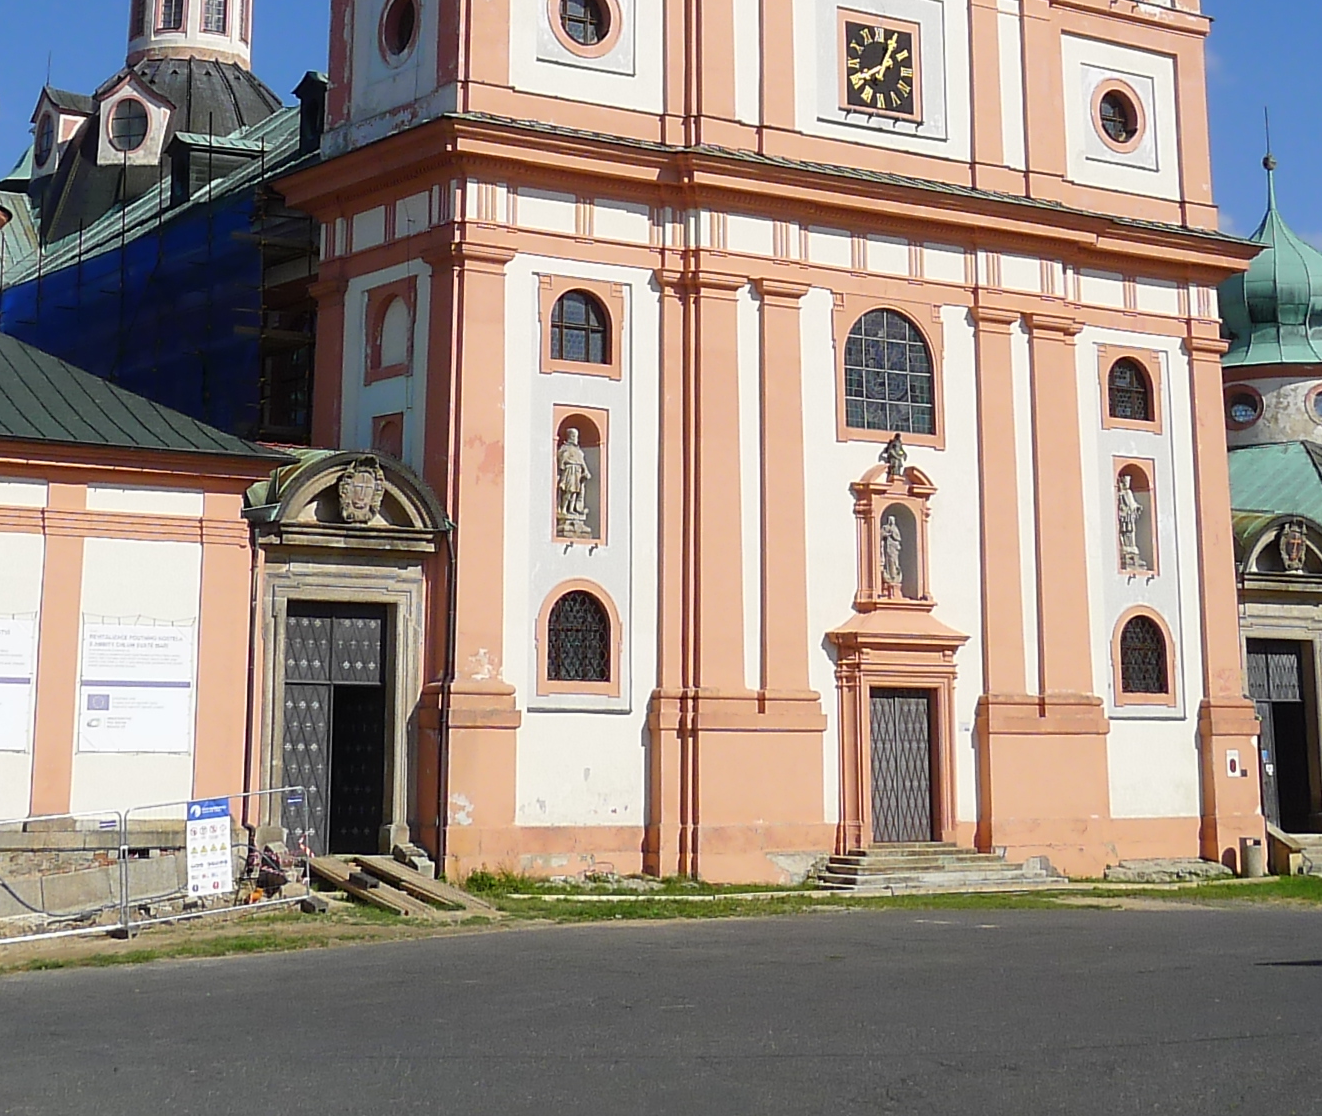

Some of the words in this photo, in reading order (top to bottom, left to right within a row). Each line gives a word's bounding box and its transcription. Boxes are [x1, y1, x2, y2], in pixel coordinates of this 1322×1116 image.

[859, 28, 873, 45] XI
[874, 27, 884, 42] XII
[850, 39, 864, 54] X
[895, 49, 909, 62] II
[900, 67, 913, 77] III
[889, 91, 902, 107] V
